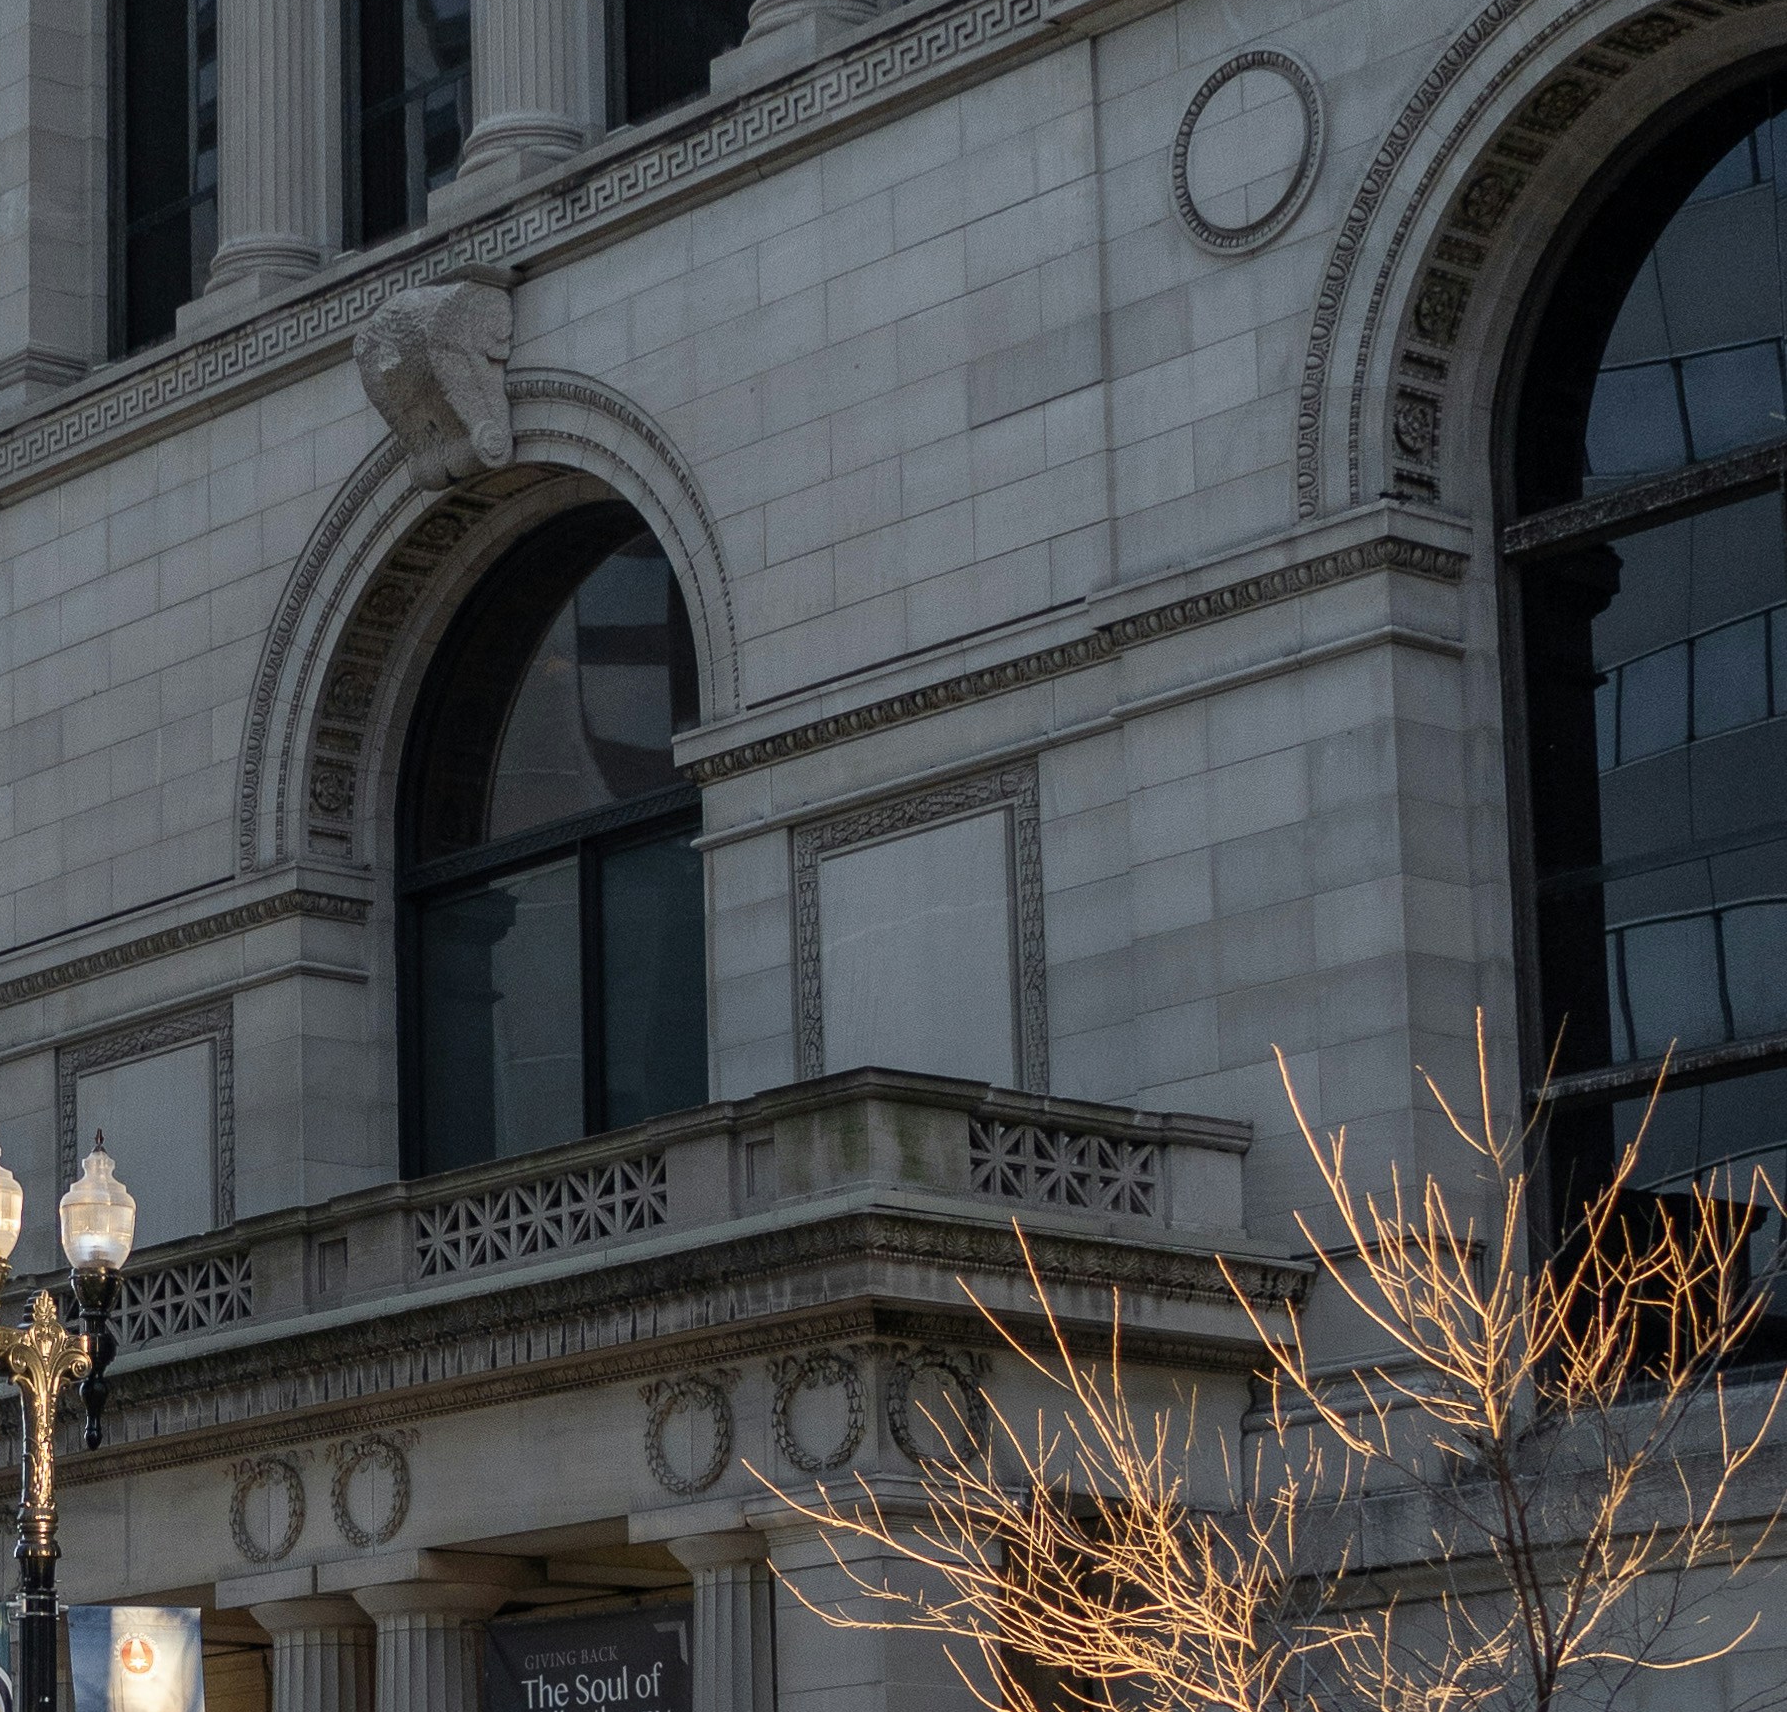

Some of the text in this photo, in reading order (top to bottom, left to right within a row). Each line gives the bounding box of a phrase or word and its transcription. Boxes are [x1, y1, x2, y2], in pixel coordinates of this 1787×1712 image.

[524, 1645, 619, 1670] GIVING BACK
[521, 1661, 663, 1709] The Soul of
